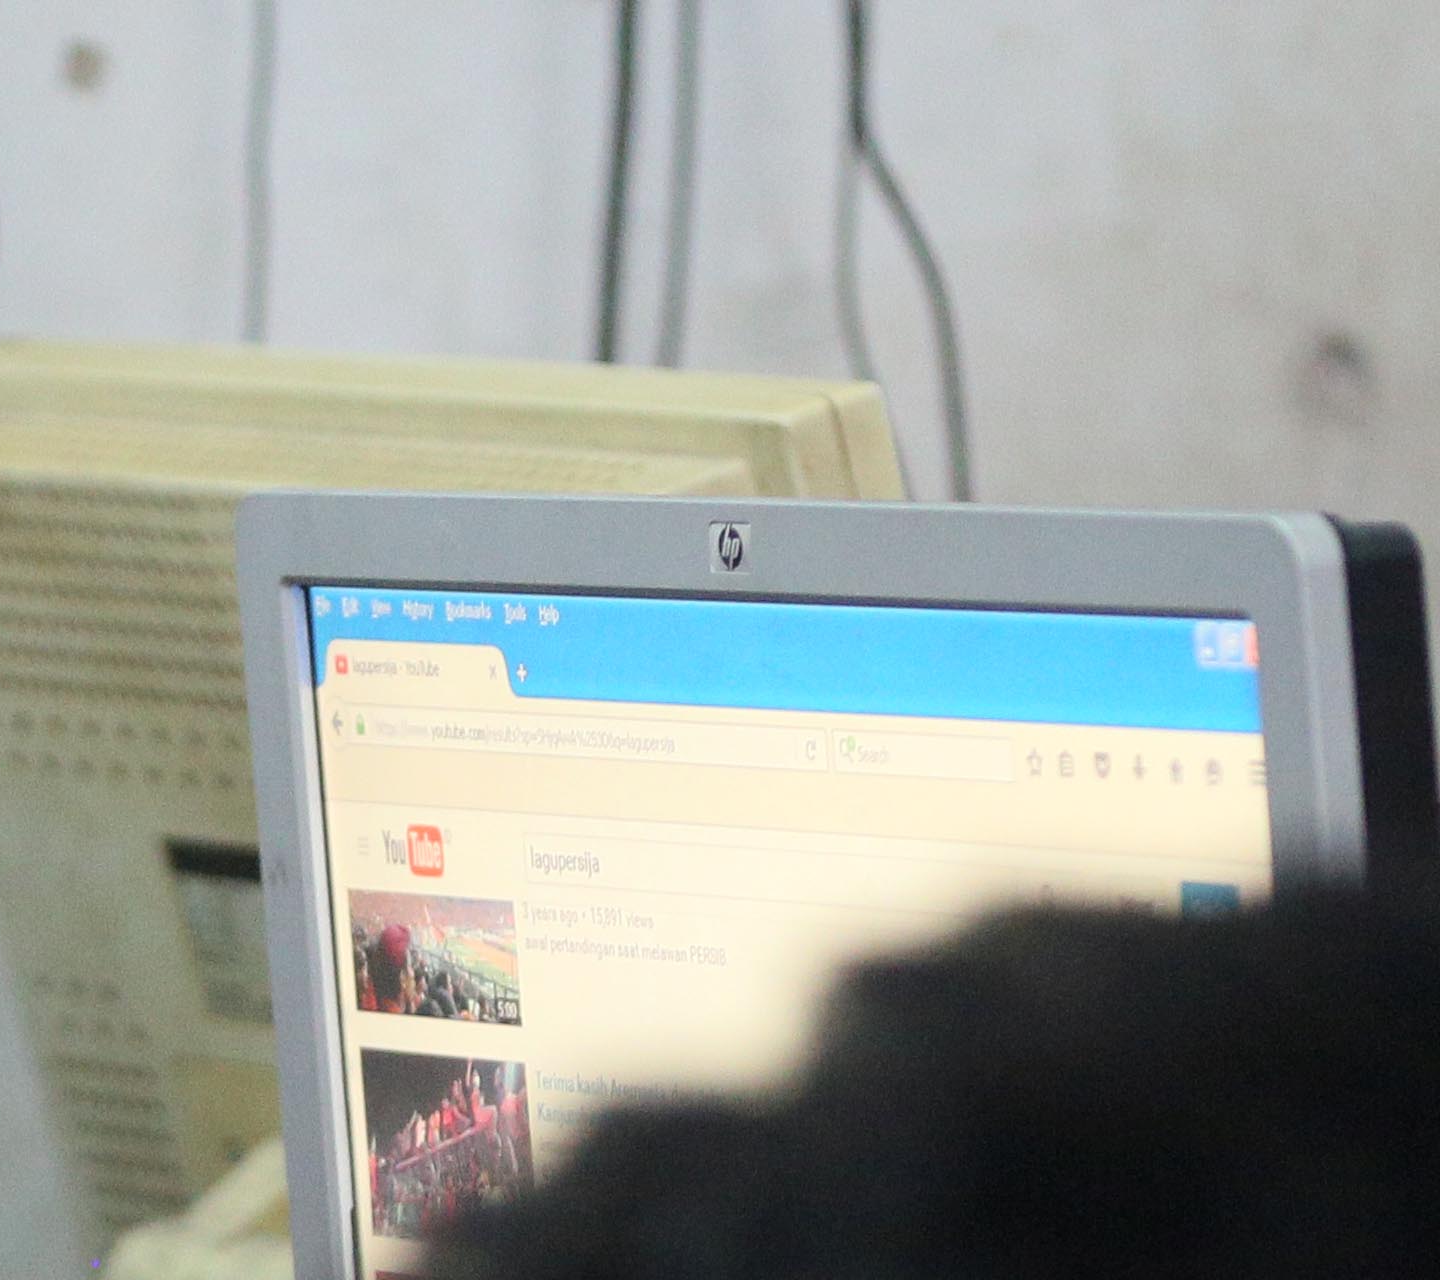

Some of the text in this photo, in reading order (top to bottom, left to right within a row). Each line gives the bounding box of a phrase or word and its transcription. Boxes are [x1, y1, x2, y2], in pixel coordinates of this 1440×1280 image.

[719, 523, 742, 571] hp
[403, 599, 434, 621] History
[445, 599, 492, 622] Bookmarks
[503, 602, 527, 624] Tools
[538, 602, 560, 626] Help
[529, 845, 600, 878] lagupersija
[531, 905, 558, 925] years
[559, 909, 579, 928] ago
[625, 914, 655, 929] views
[550, 937, 616, 960] pertandingan
[617, 943, 640, 957] saat
[641, 946, 688, 963] melawan
[690, 946, 728, 966] PERSIB
[535, 1071, 574, 1093] Terima
